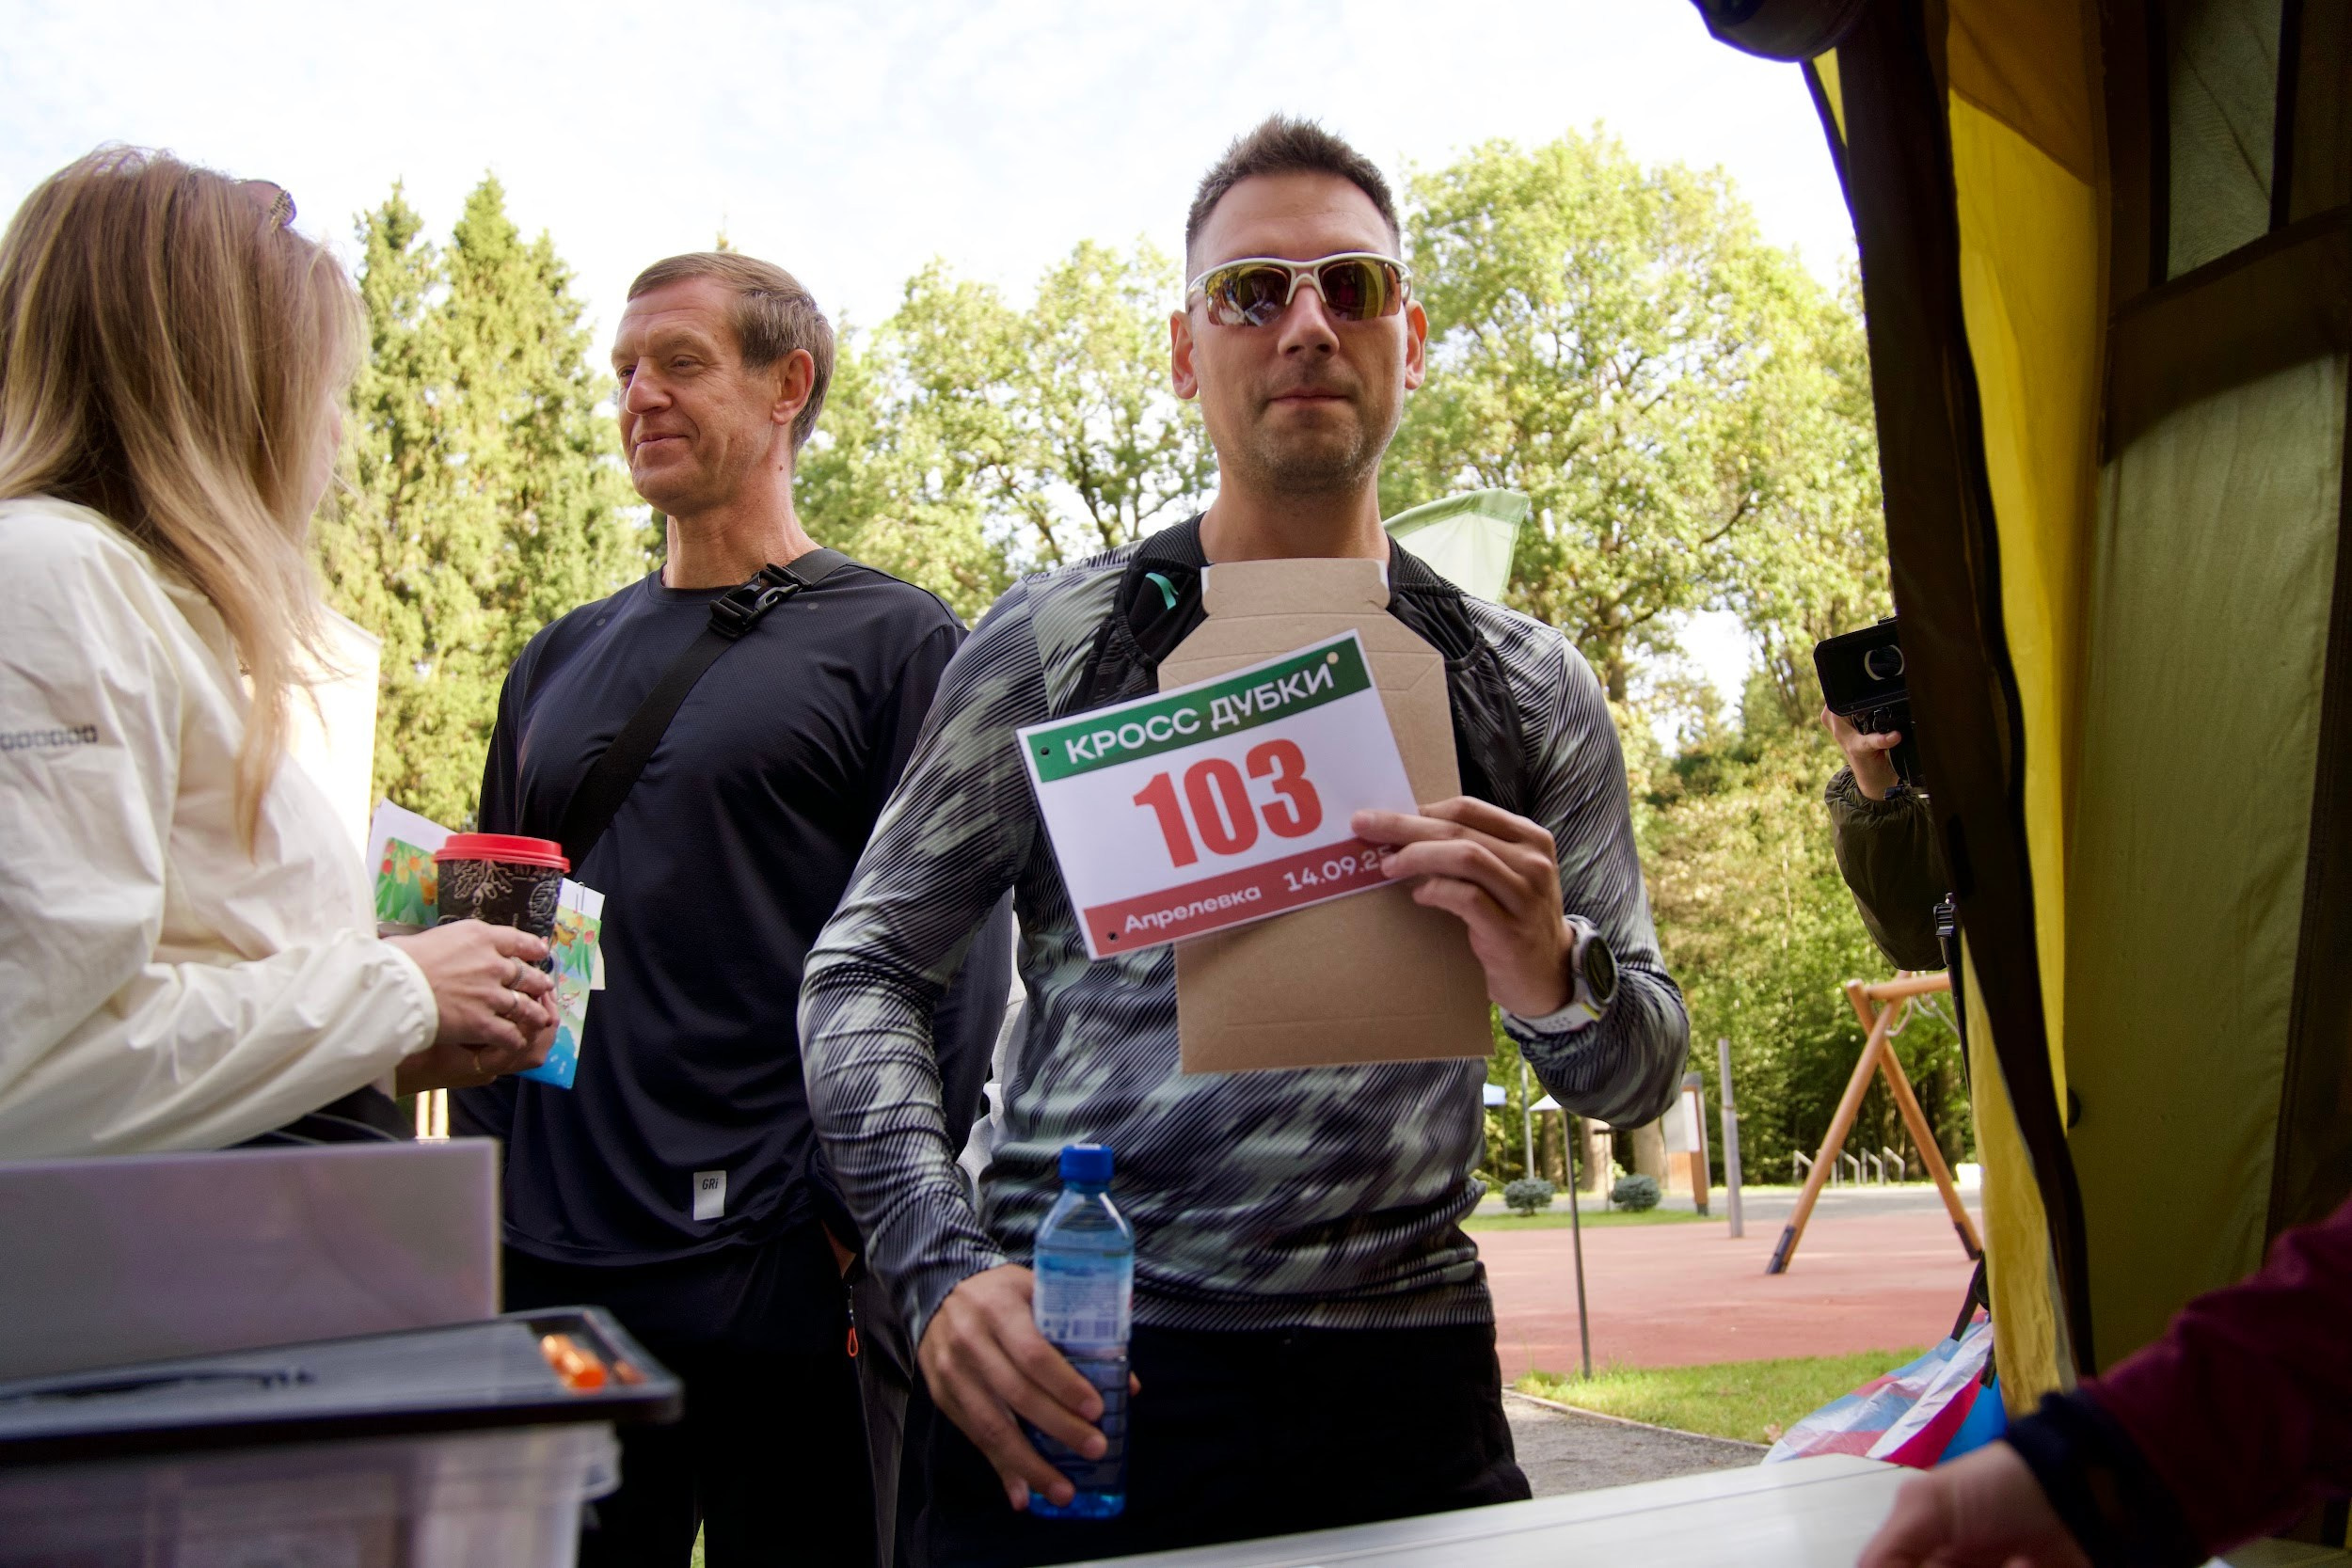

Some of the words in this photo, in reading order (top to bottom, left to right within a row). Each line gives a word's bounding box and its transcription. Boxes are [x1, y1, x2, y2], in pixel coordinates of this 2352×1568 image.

[1065, 707, 1200, 764] КРОСС
[1211, 663, 1335, 731] ДУБКИ
[1133, 738, 1323, 868] 103
[1124, 886, 1262, 933] Апрелевка
